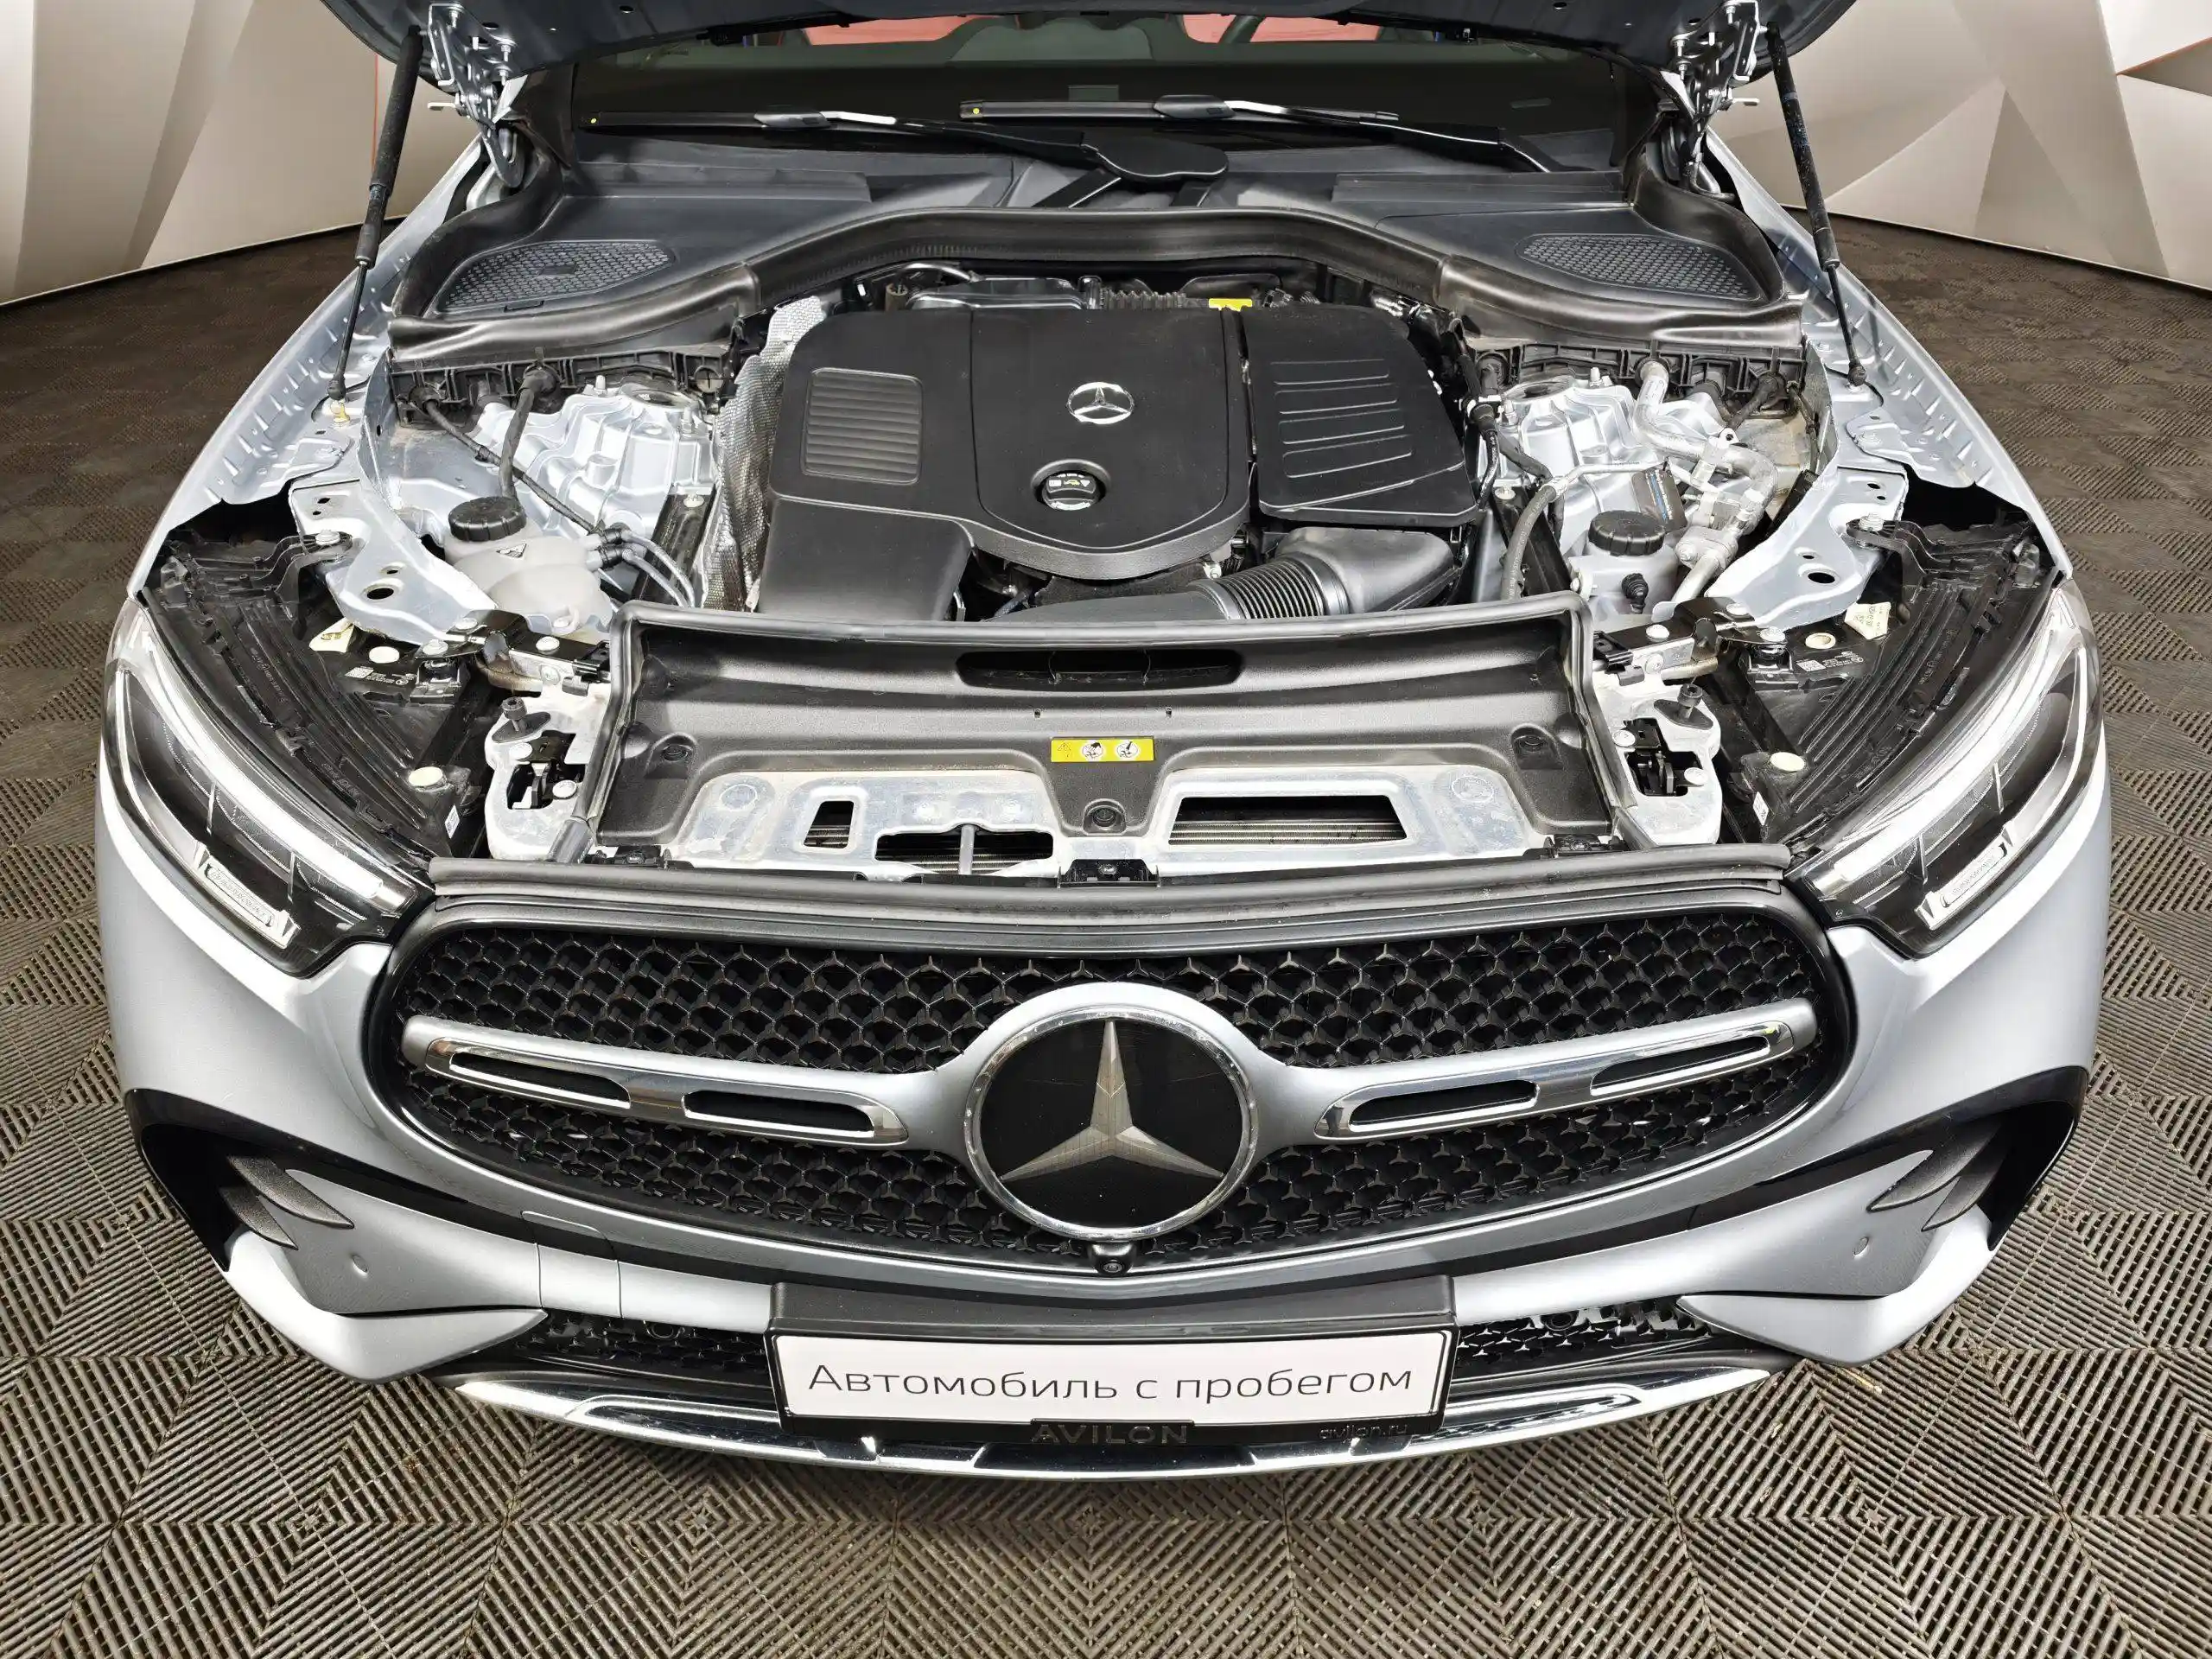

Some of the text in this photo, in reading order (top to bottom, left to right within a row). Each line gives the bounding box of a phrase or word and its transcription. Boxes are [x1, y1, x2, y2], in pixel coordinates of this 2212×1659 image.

[808, 1364, 1412, 1404] Автомобиль с пробегом
[1031, 1424, 1187, 1444] AVILON
